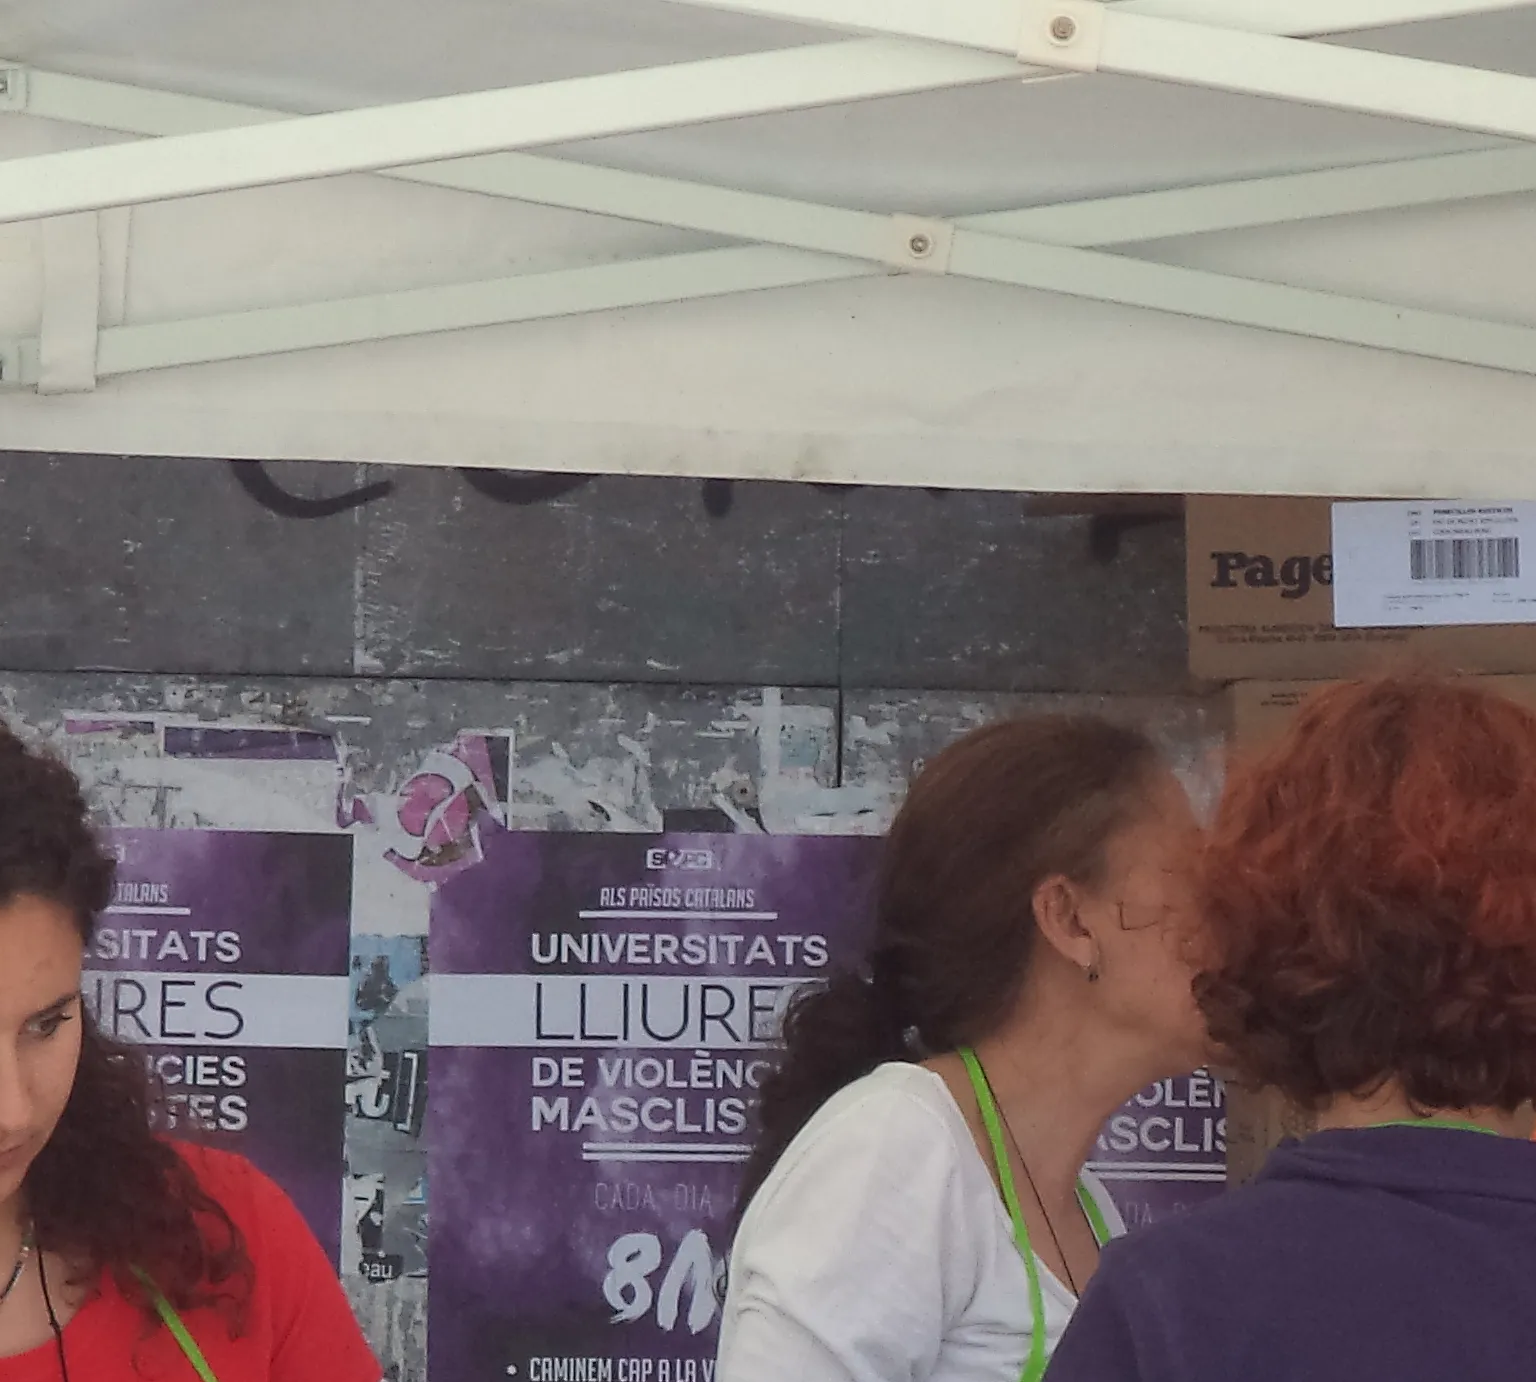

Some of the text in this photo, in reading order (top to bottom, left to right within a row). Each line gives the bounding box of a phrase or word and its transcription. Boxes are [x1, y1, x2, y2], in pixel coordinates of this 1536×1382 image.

[600, 886, 626, 907] ALS
[685, 888, 755, 909] CATALANS
[86, 929, 242, 964] SITATS
[531, 933, 829, 966] UNIVERSITATS
[150, 1053, 247, 1087] CIES
[531, 1056, 585, 1087] DE
[531, 1096, 755, 1133] MASCLIS
[530, 1357, 613, 1382] CAMINEM
[618, 1358, 653, 1382] CAP
[658, 1359, 671, 1382] A
[676, 1360, 698, 1382] LA
